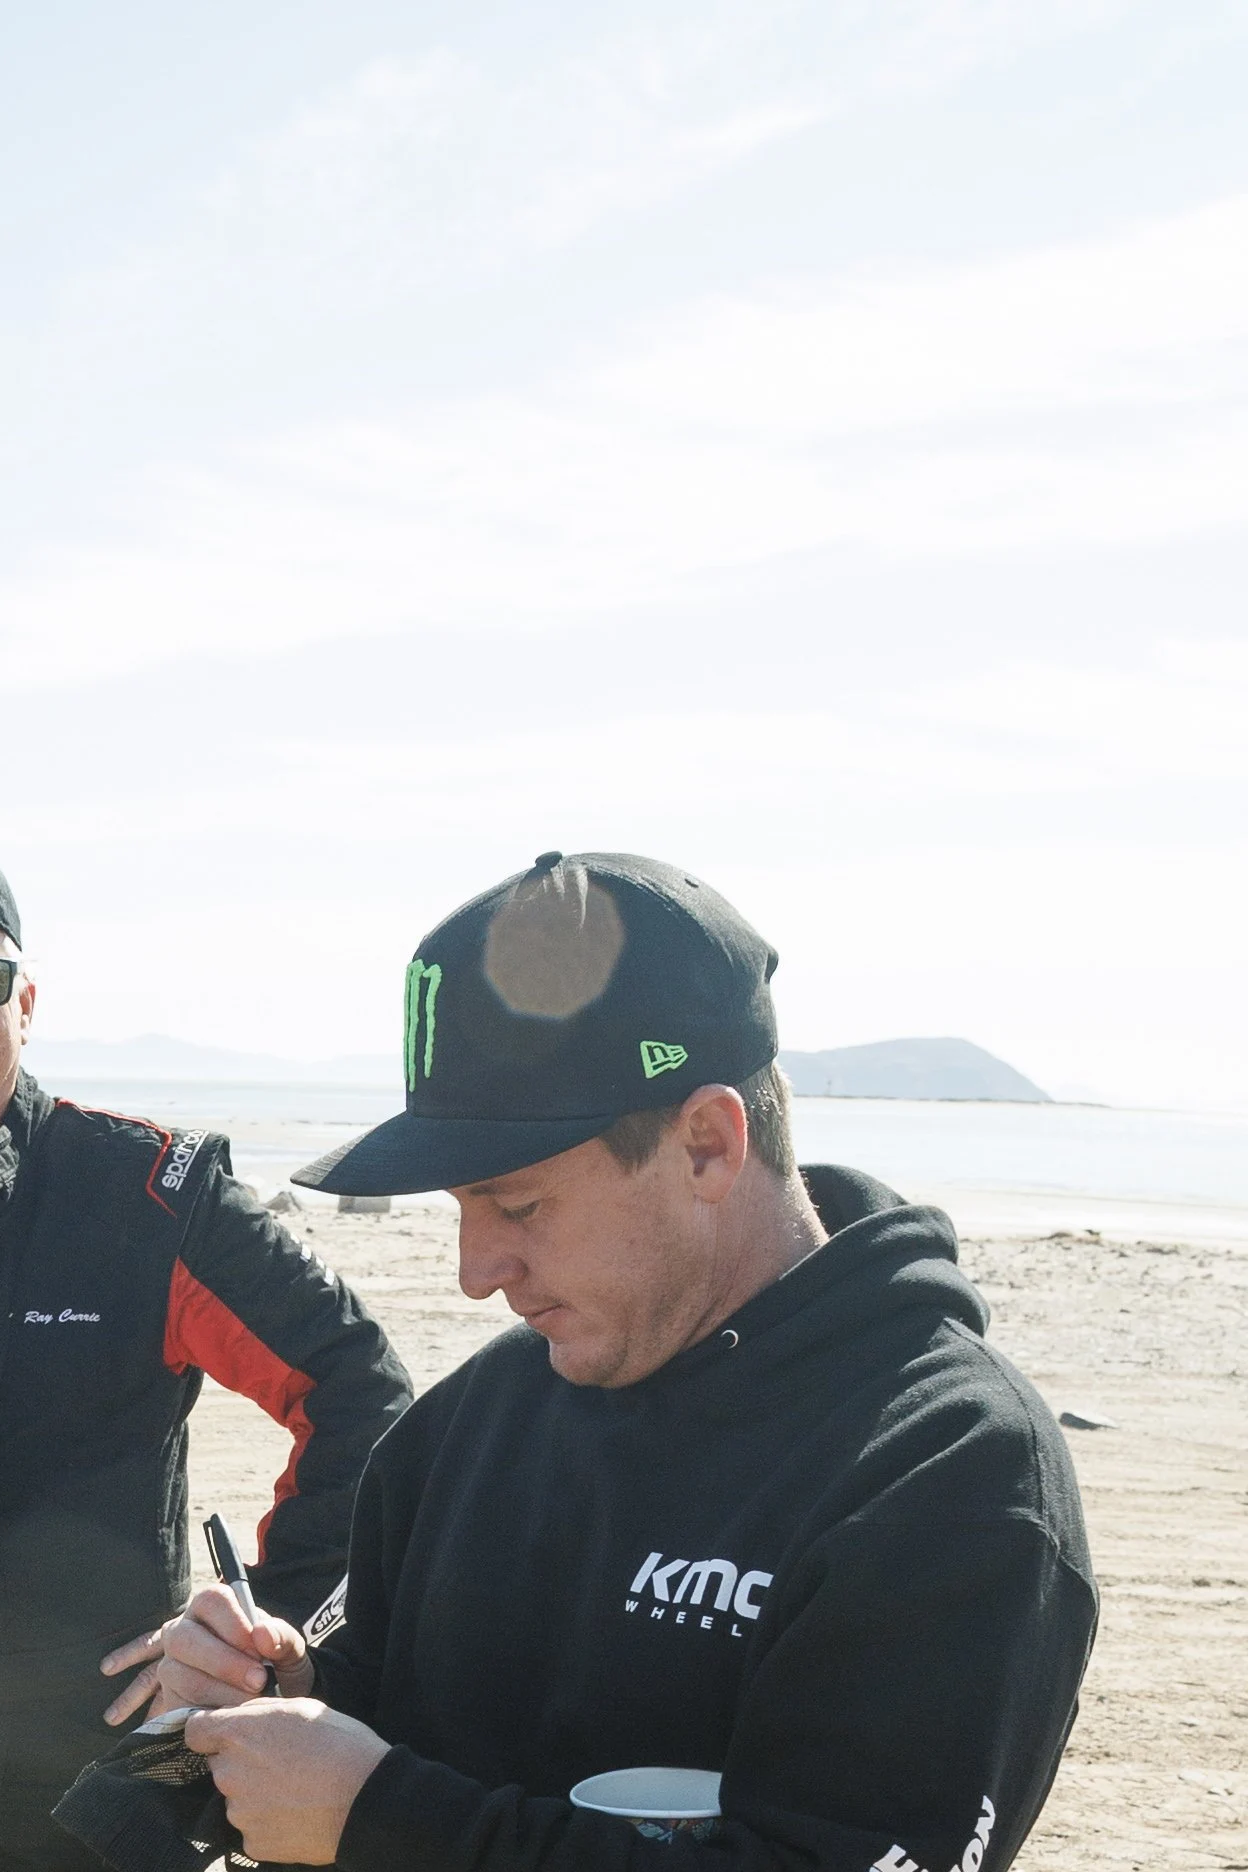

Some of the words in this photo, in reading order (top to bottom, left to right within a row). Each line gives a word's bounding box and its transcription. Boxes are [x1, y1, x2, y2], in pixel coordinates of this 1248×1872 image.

[161, 1129, 205, 1190] sparco
[24, 1310, 53, 1325] Ray
[58, 1308, 100, 1322] Currie
